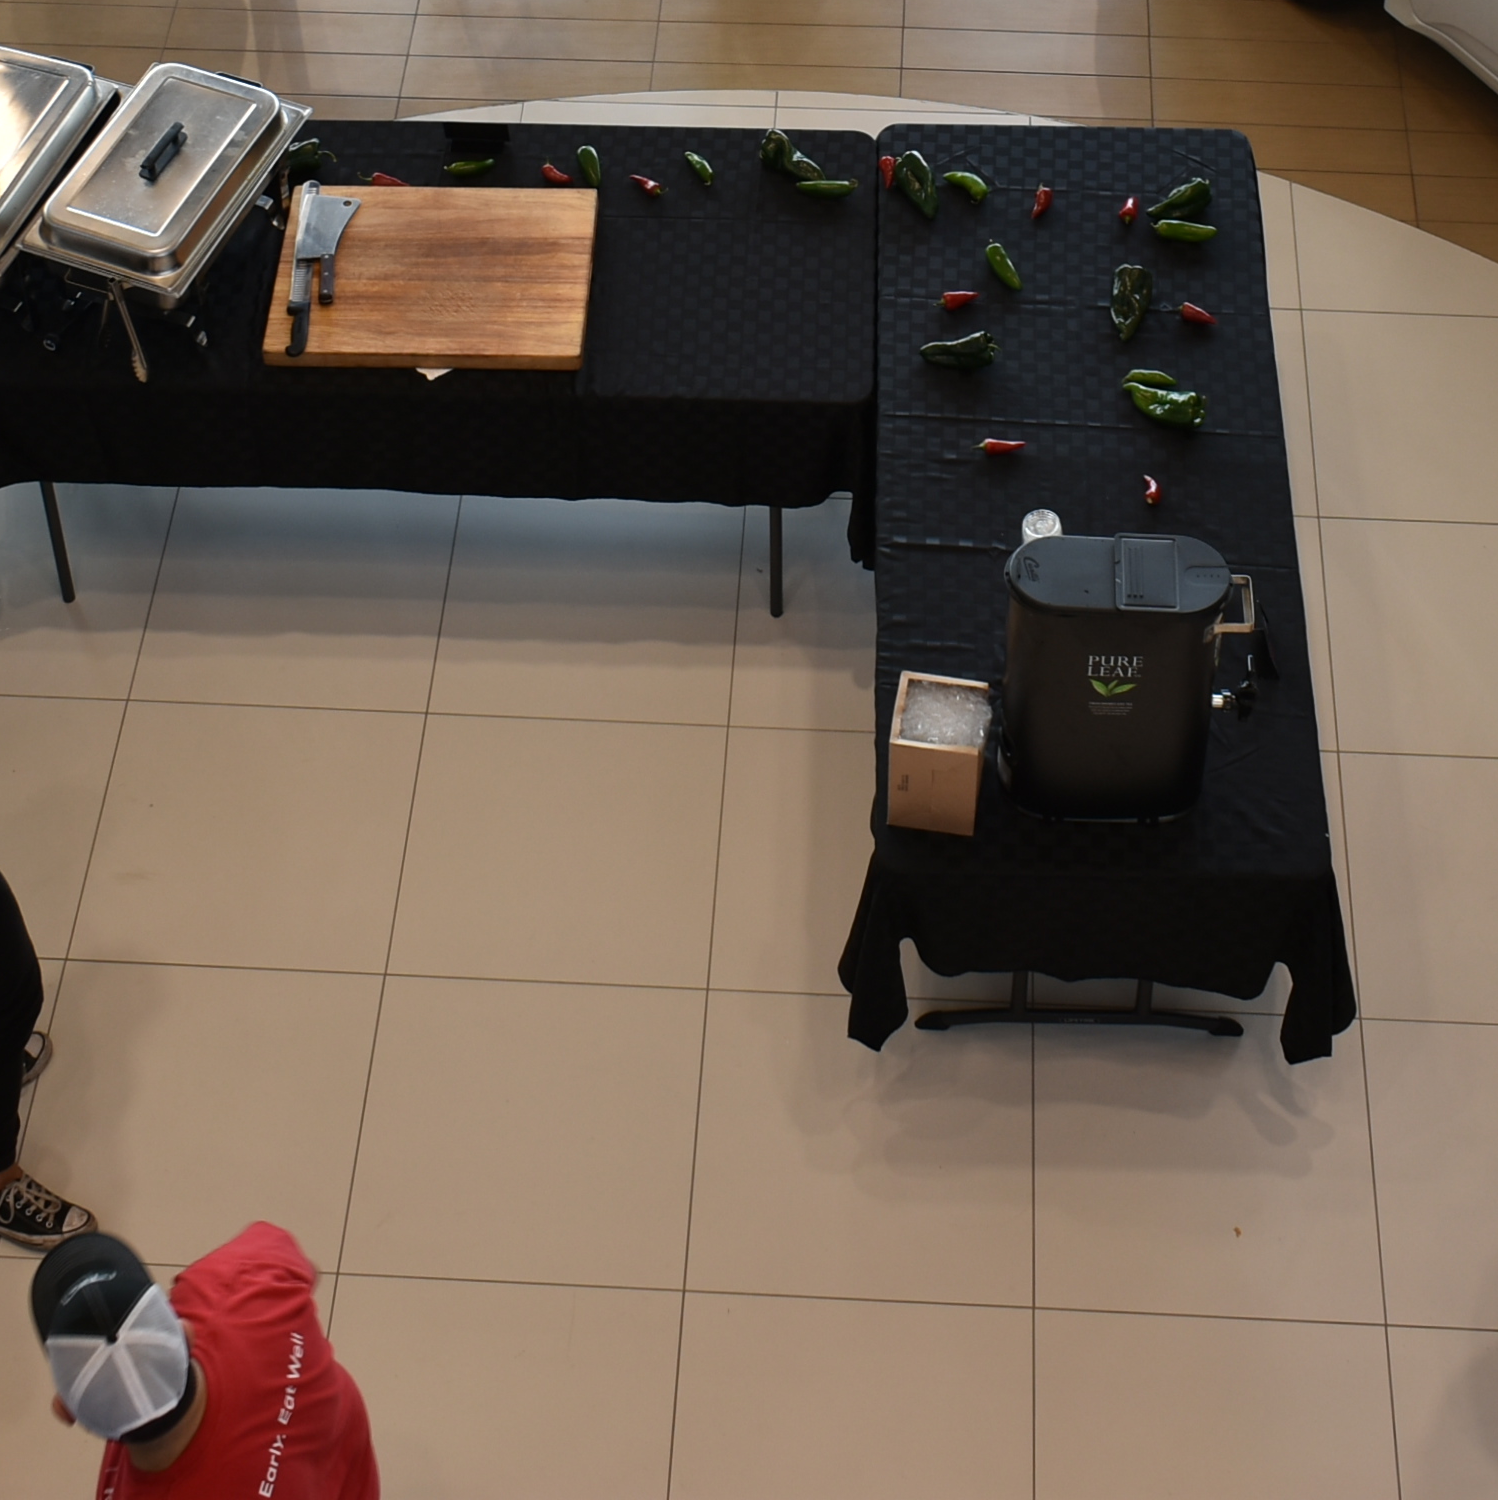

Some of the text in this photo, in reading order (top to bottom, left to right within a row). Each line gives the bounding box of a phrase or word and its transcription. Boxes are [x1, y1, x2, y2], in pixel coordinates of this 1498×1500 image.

[1087, 654, 1144, 667] PURE
[1087, 665, 1138, 678] LEAF
[258, 1332, 304, 1498] Early. Eat Well
